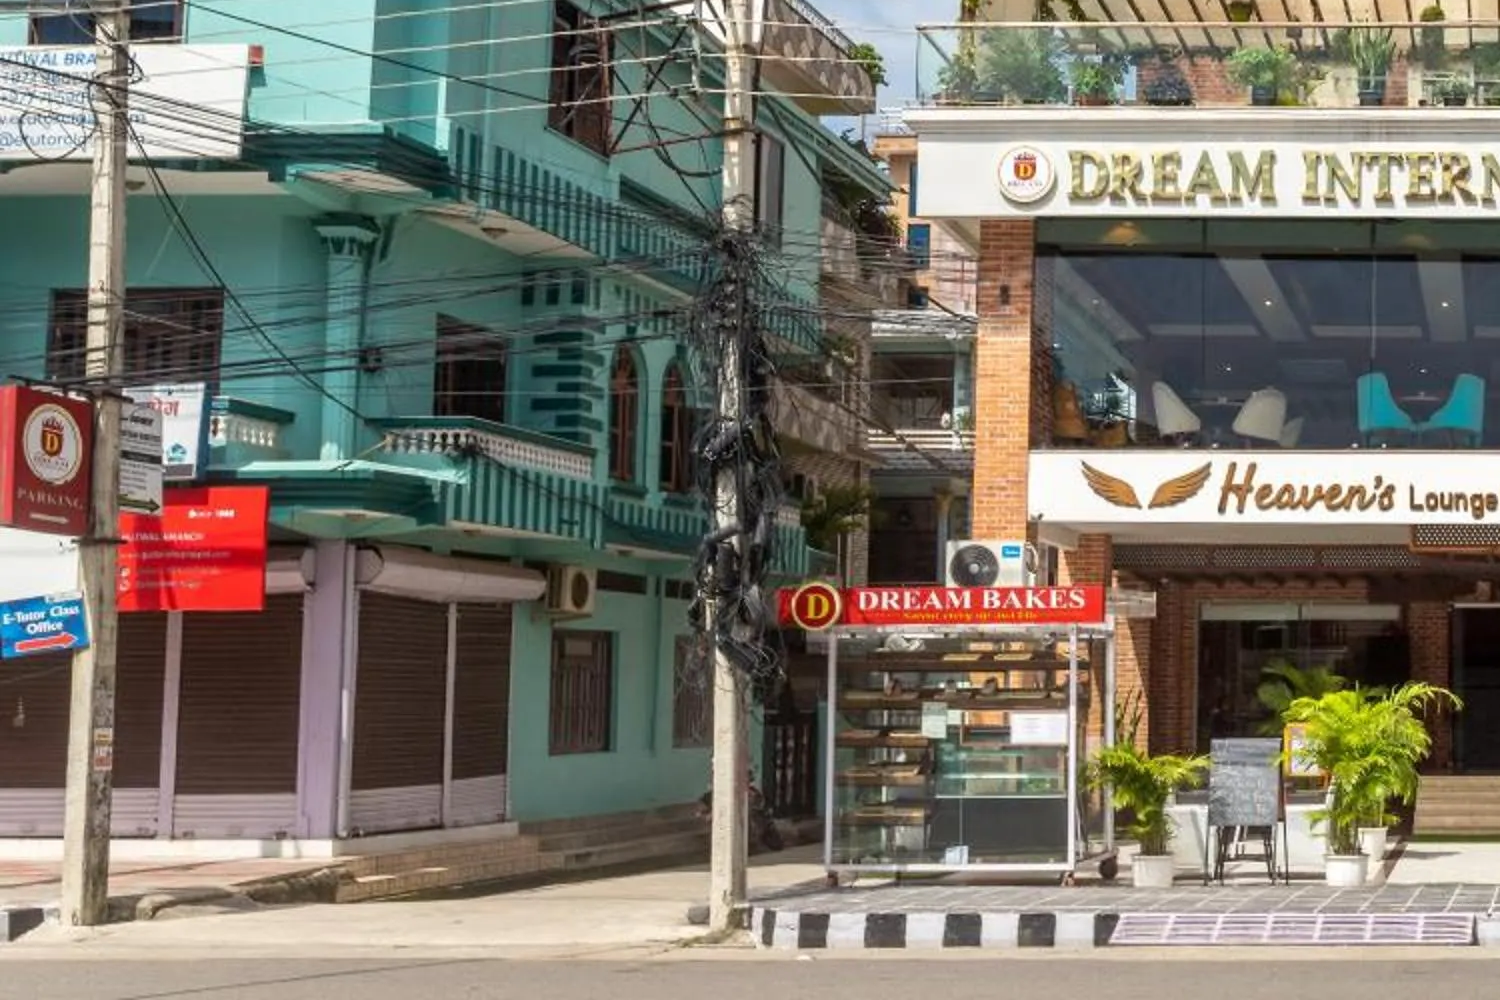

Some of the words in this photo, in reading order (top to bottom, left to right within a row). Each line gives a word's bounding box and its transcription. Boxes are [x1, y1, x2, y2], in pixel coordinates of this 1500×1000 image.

[1067, 149, 1277, 205] DREAM
[16, 487, 84, 509] PARKING
[1217, 460, 1396, 516] Heaven's
[1409, 481, 1499, 520] Lounge
[806, 593, 830, 619] D
[858, 590, 972, 611] DREAM
[983, 589, 1087, 609] BAKES
[3, 610, 46, 625] E-Tutor
[49, 605, 80, 617] Class
[26, 620, 64, 635] Office
